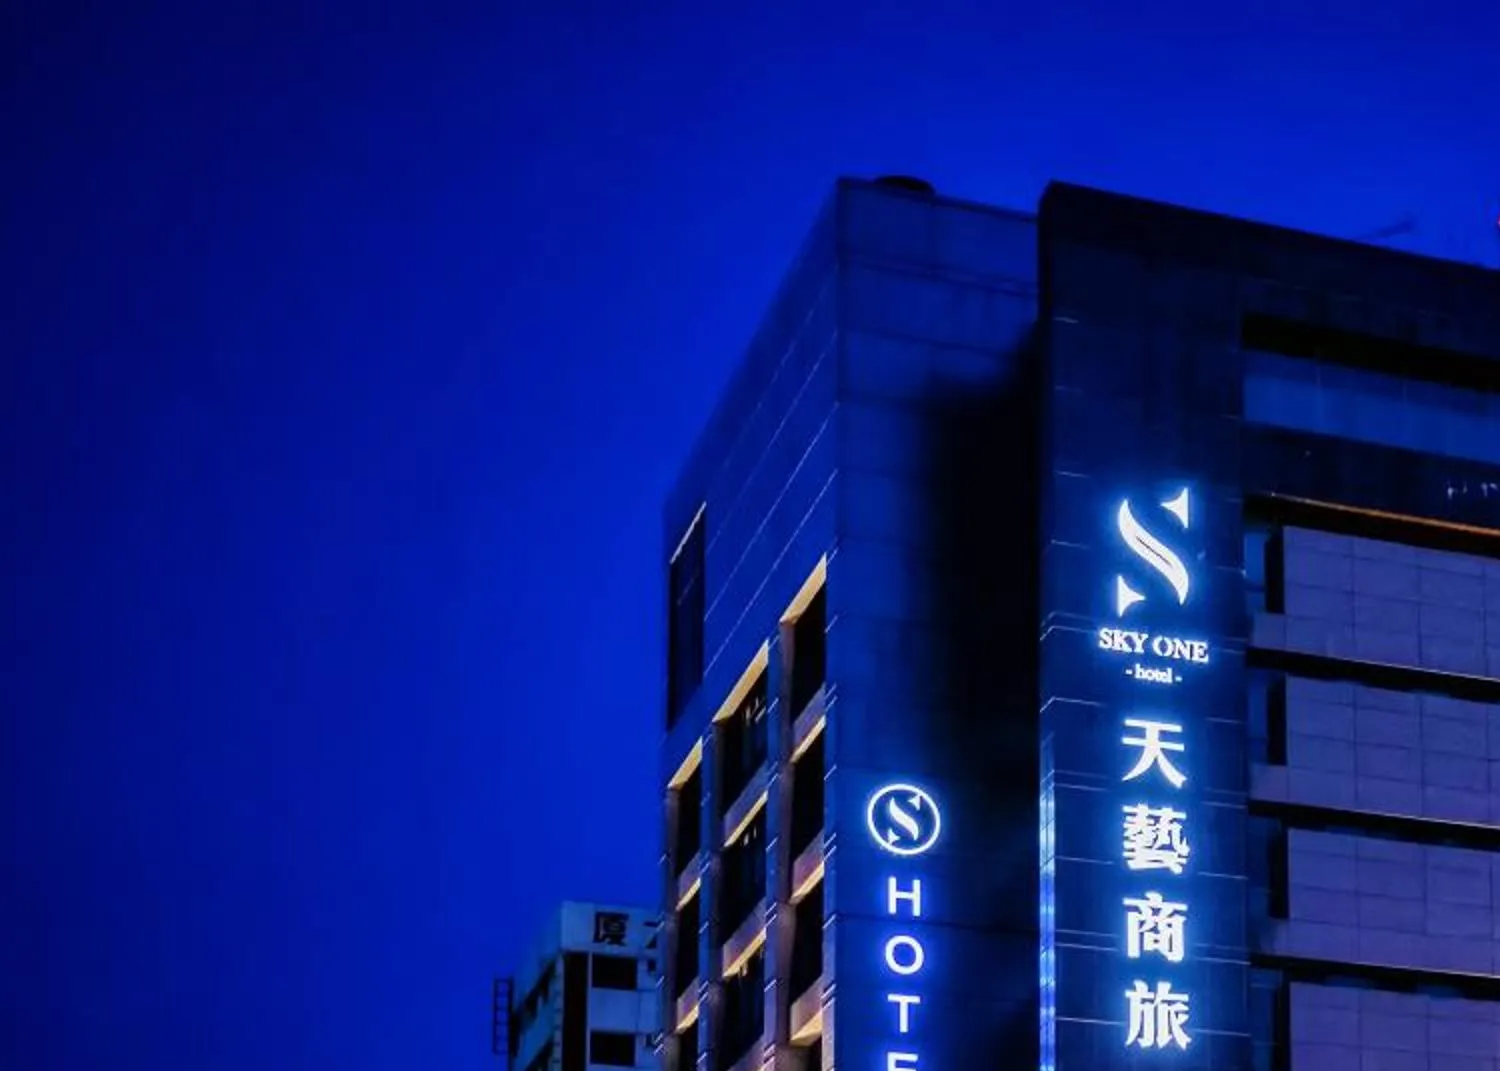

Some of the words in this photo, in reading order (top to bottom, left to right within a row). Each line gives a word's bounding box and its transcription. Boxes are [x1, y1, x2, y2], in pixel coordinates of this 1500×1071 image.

[1098, 627, 1150, 655] SKY
[1151, 635, 1210, 664] ONE
[1121, 717, 1193, 1051] 天藝商旅
